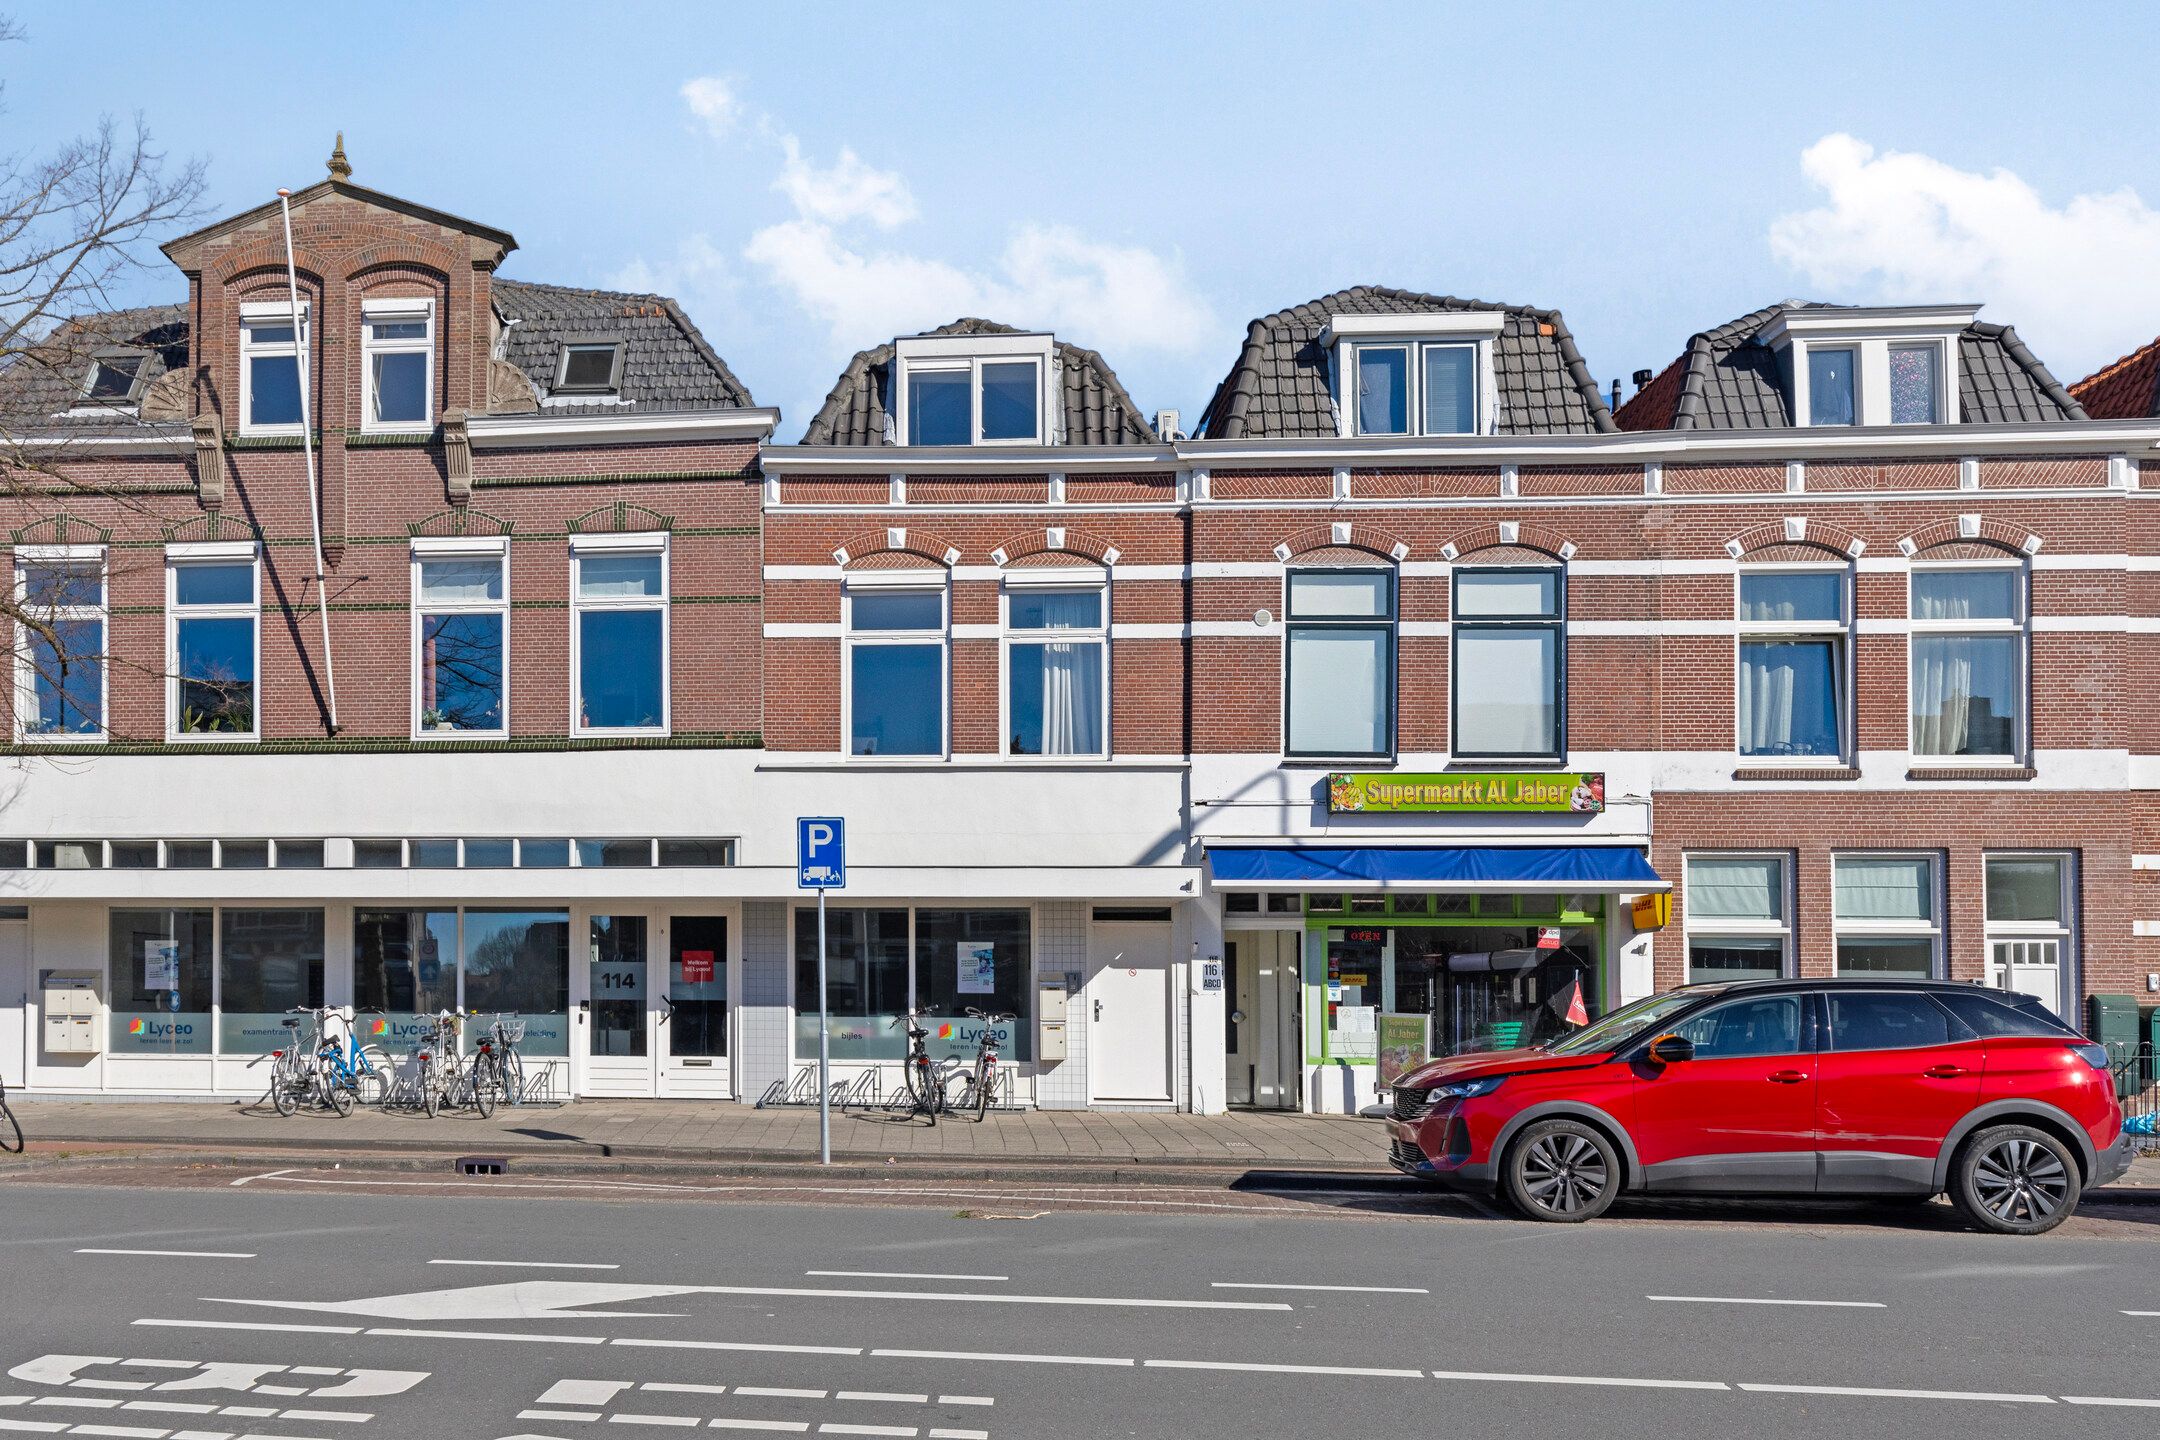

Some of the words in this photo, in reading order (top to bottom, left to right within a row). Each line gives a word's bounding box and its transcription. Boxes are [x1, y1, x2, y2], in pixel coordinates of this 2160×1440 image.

[1366, 779, 1483, 809] Supermarkt
[1487, 780, 1509, 804] Al
[1512, 780, 1568, 805] Jaber
[808, 823, 834, 859] P
[1350, 931, 1381, 941] OPEN
[1548, 929, 1560, 937] dpd
[1204, 964, 1218, 976] 116
[601, 972, 636, 989] 114
[1203, 979, 1222, 988] ABCD
[149, 1021, 193, 1037] Lyceo
[960, 1026, 1007, 1043] Lyceo
[841, 1031, 863, 1042] bijles
